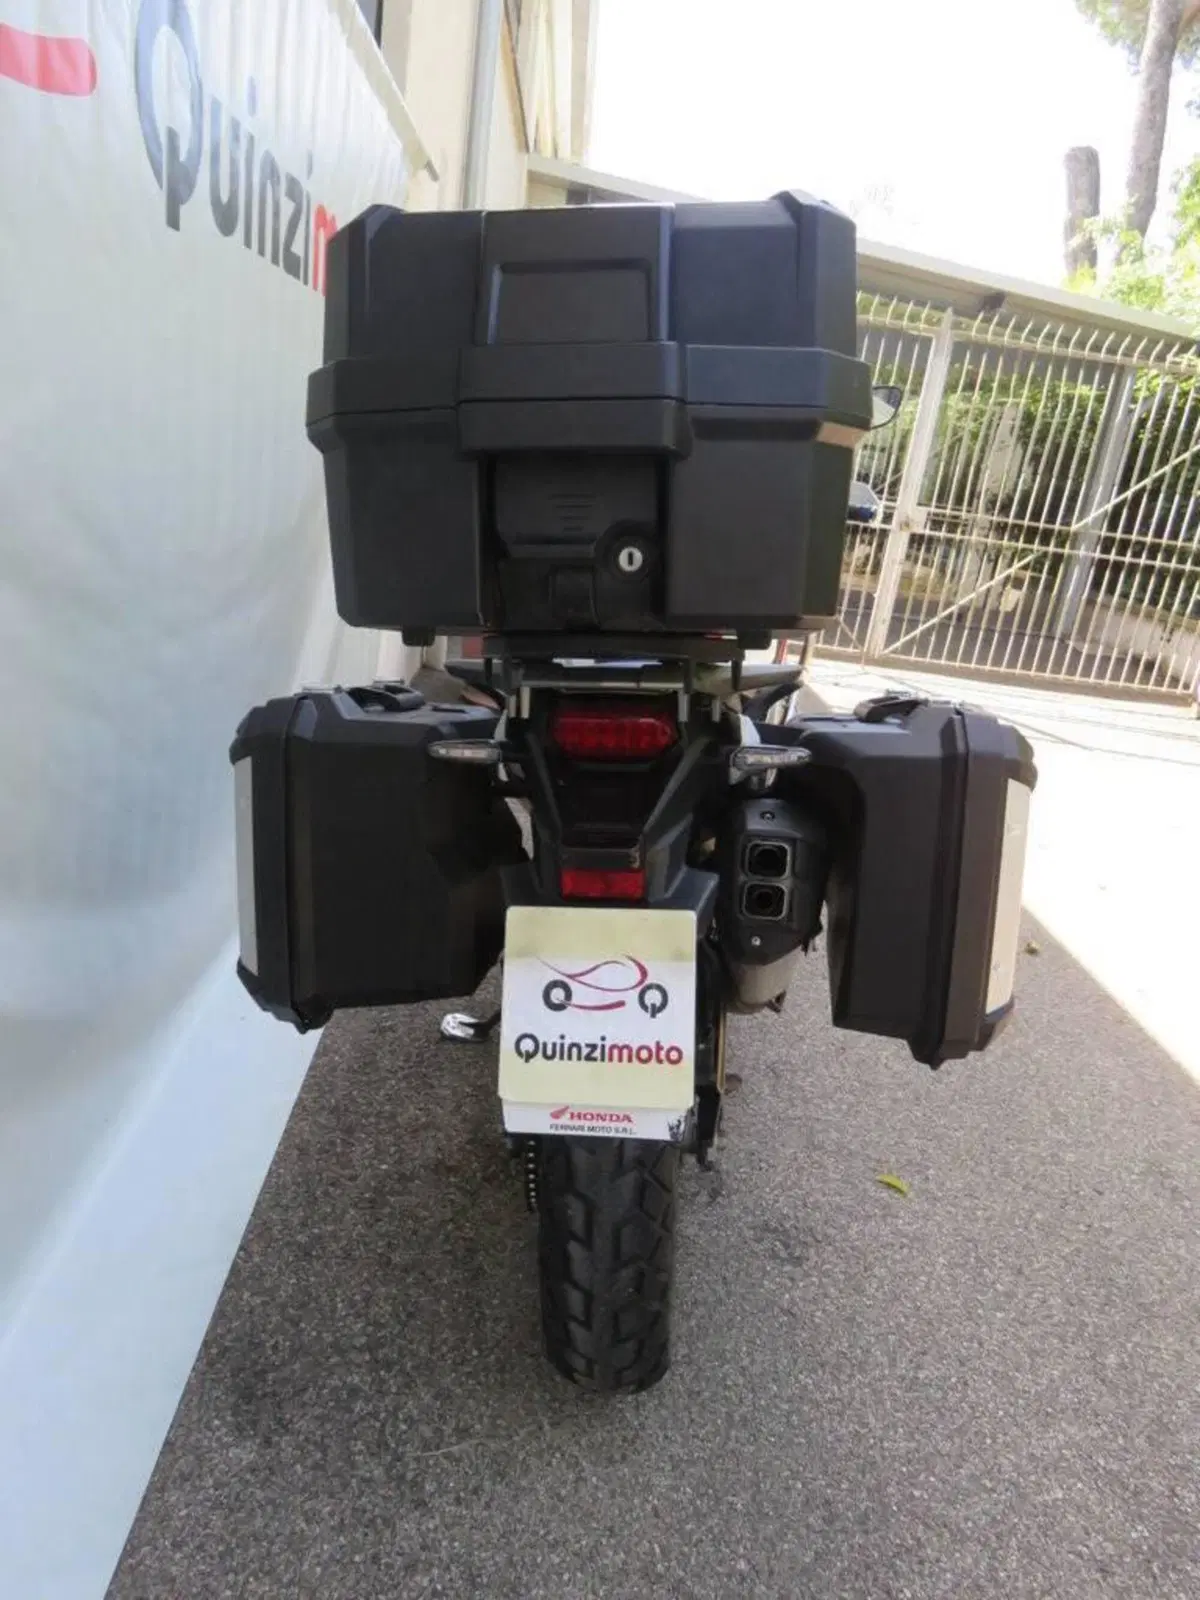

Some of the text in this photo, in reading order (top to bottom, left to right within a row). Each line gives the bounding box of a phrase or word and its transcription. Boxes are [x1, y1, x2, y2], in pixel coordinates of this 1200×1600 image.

[514, 1032, 684, 1066] Quinzimoto
[570, 1111, 633, 1123] HONDA
[587, 1125, 613, 1135] MOTO
